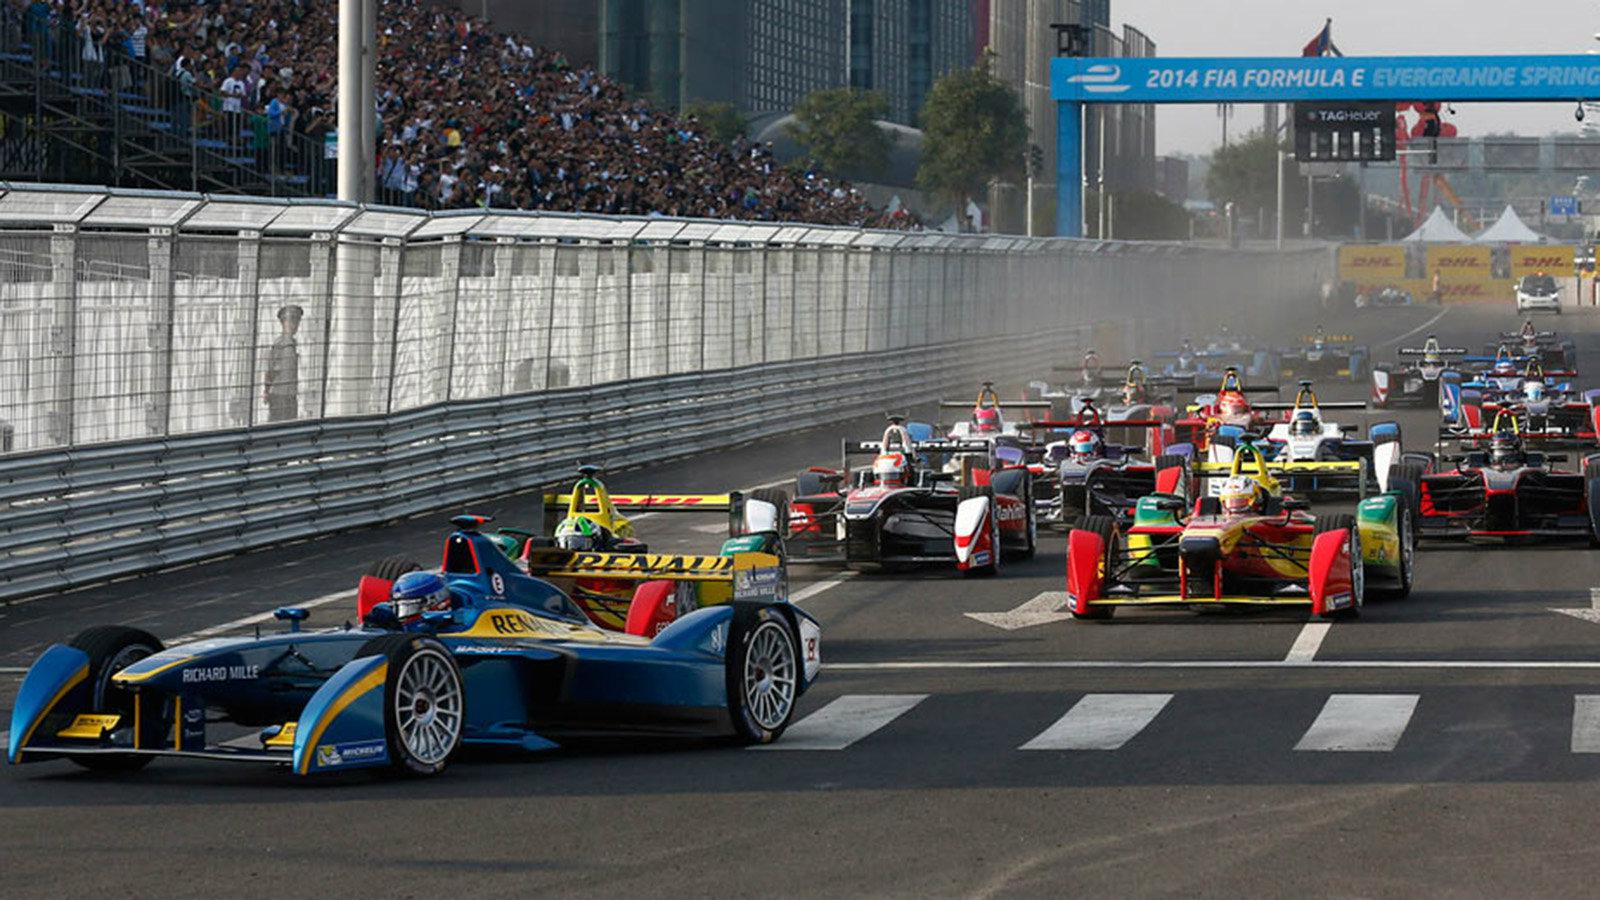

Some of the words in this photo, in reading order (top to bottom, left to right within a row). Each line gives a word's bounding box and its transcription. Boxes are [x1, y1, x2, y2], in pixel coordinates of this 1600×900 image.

[1146, 69, 1198, 88] 2014
[1203, 69, 1237, 87] FIA
[1243, 68, 1345, 87] FORMULA
[1351, 68, 1365, 86] E
[1373, 66, 1516, 87] EVERGRANDE
[1438, 256, 1481, 267] DHL
[1522, 256, 1565, 268] DHL
[183, 667, 226, 683] RICHARD
[229, 665, 259, 680] MILLE
